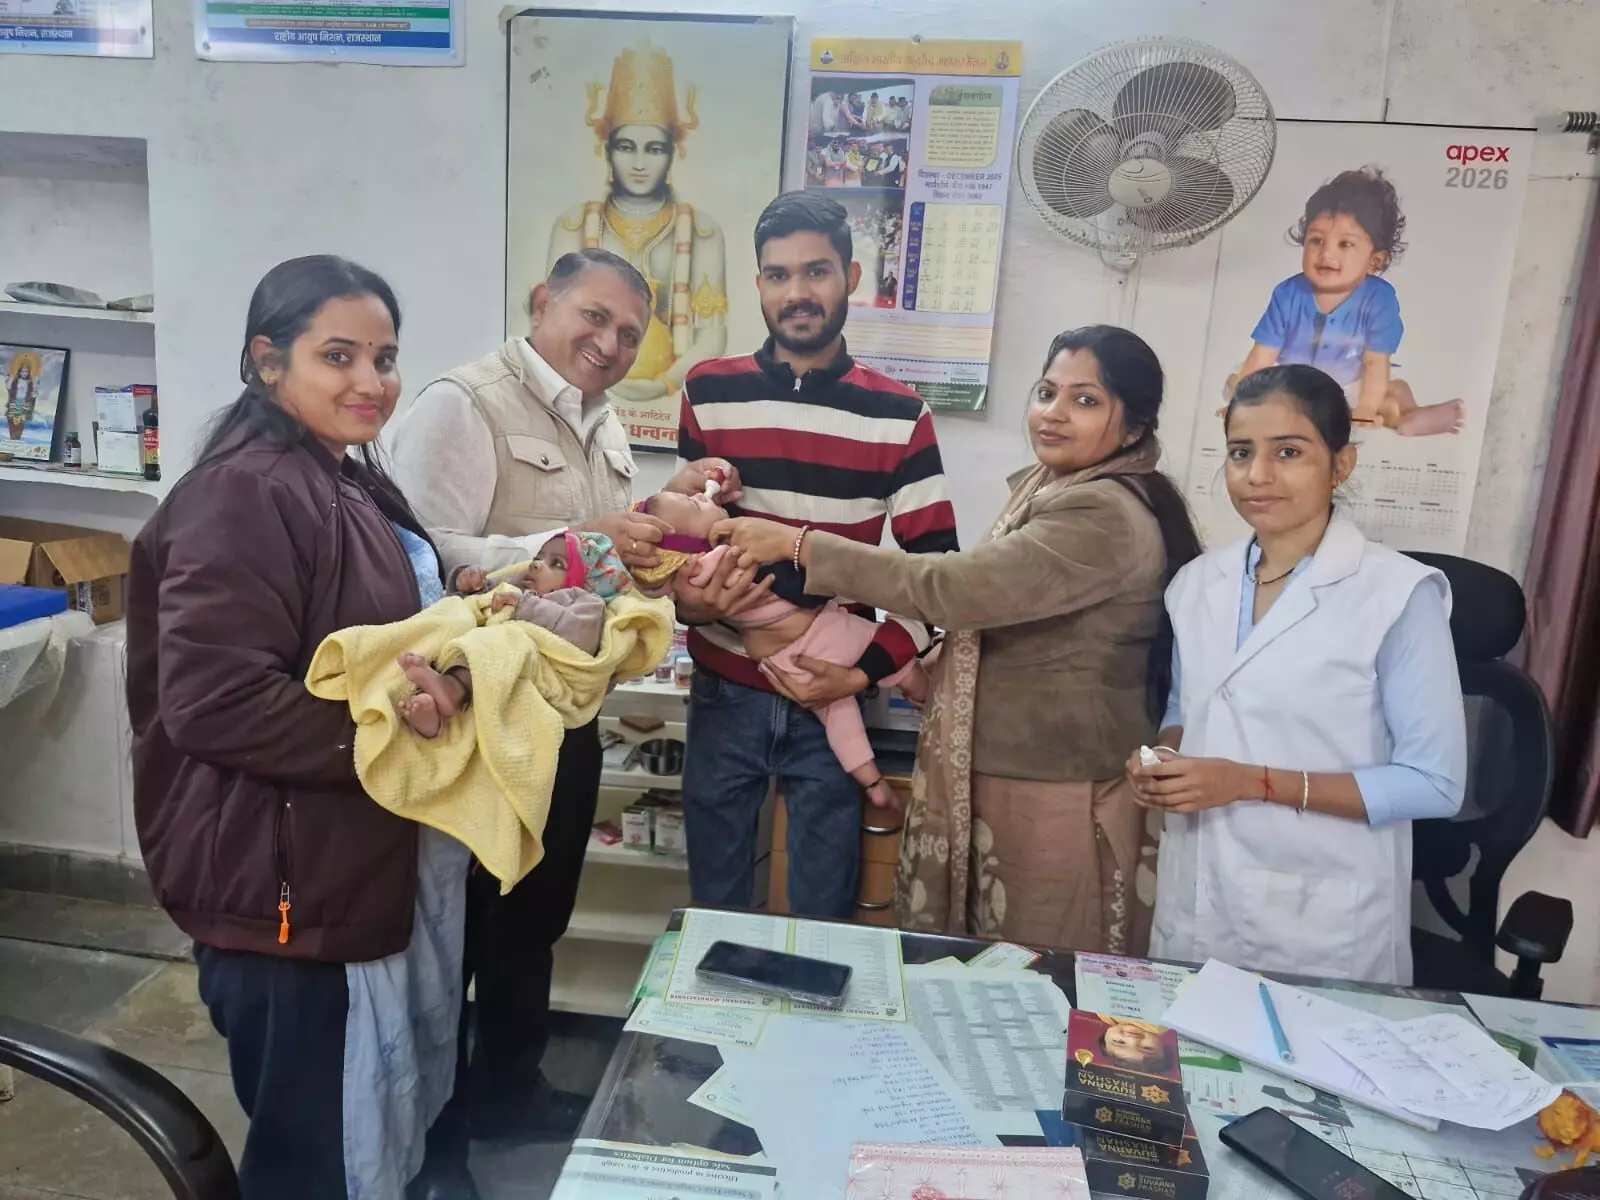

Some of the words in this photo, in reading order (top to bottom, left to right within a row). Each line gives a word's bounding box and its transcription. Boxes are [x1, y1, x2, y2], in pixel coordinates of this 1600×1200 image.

[346, 33, 381, 43] राजस्थान
[1446, 144, 1510, 165] apex
[1444, 167, 1508, 190] 2026
[1079, 1071, 1136, 1089] PRASHAN
[1080, 1078, 1136, 1095] SUVARNA
[1099, 1143, 1157, 1158] SUVARNA
[677, 1157, 709, 1167] option
[1140, 1177, 1176, 1188] SUVARNA
